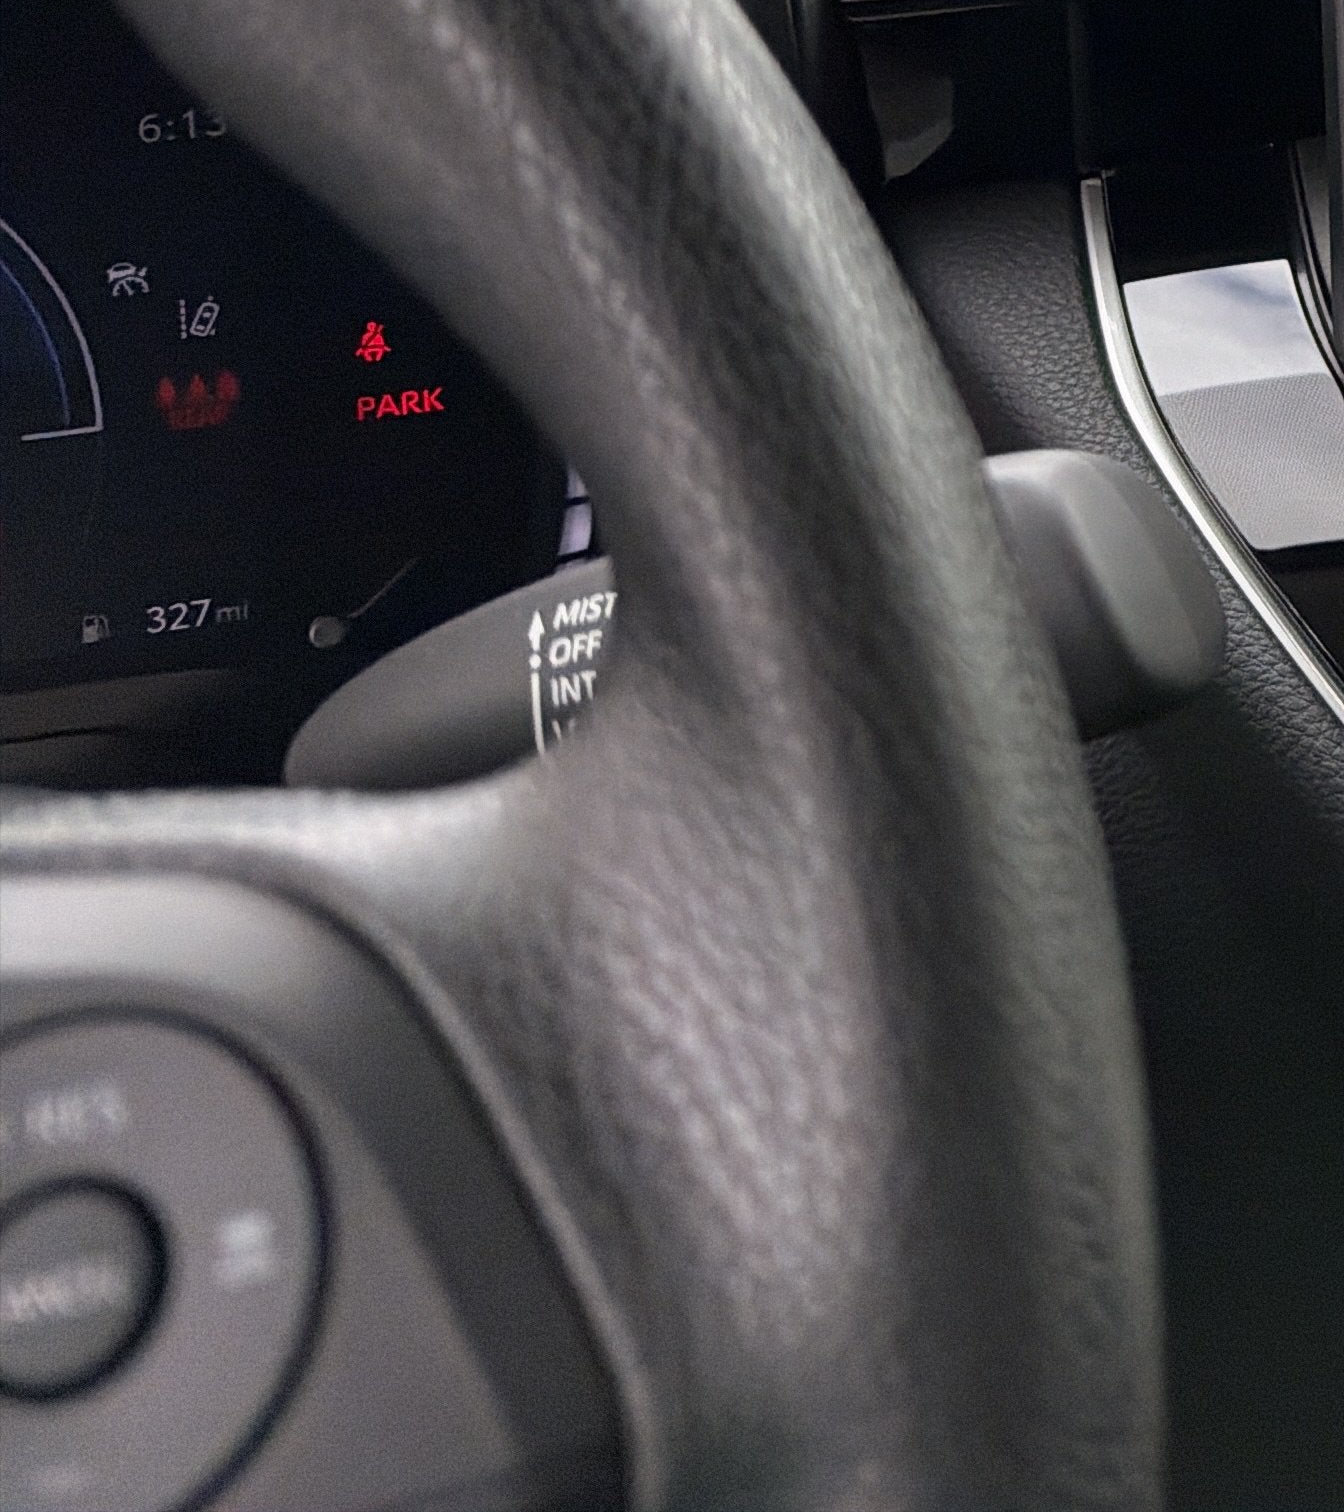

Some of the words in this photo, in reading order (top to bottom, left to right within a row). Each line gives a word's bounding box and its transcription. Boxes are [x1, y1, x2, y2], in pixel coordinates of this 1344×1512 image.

[356, 387, 444, 421] PARK
[146, 598, 212, 634] 327
[553, 592, 617, 631] MIST
[549, 629, 602, 668] OFF
[550, 670, 597, 707] INT
